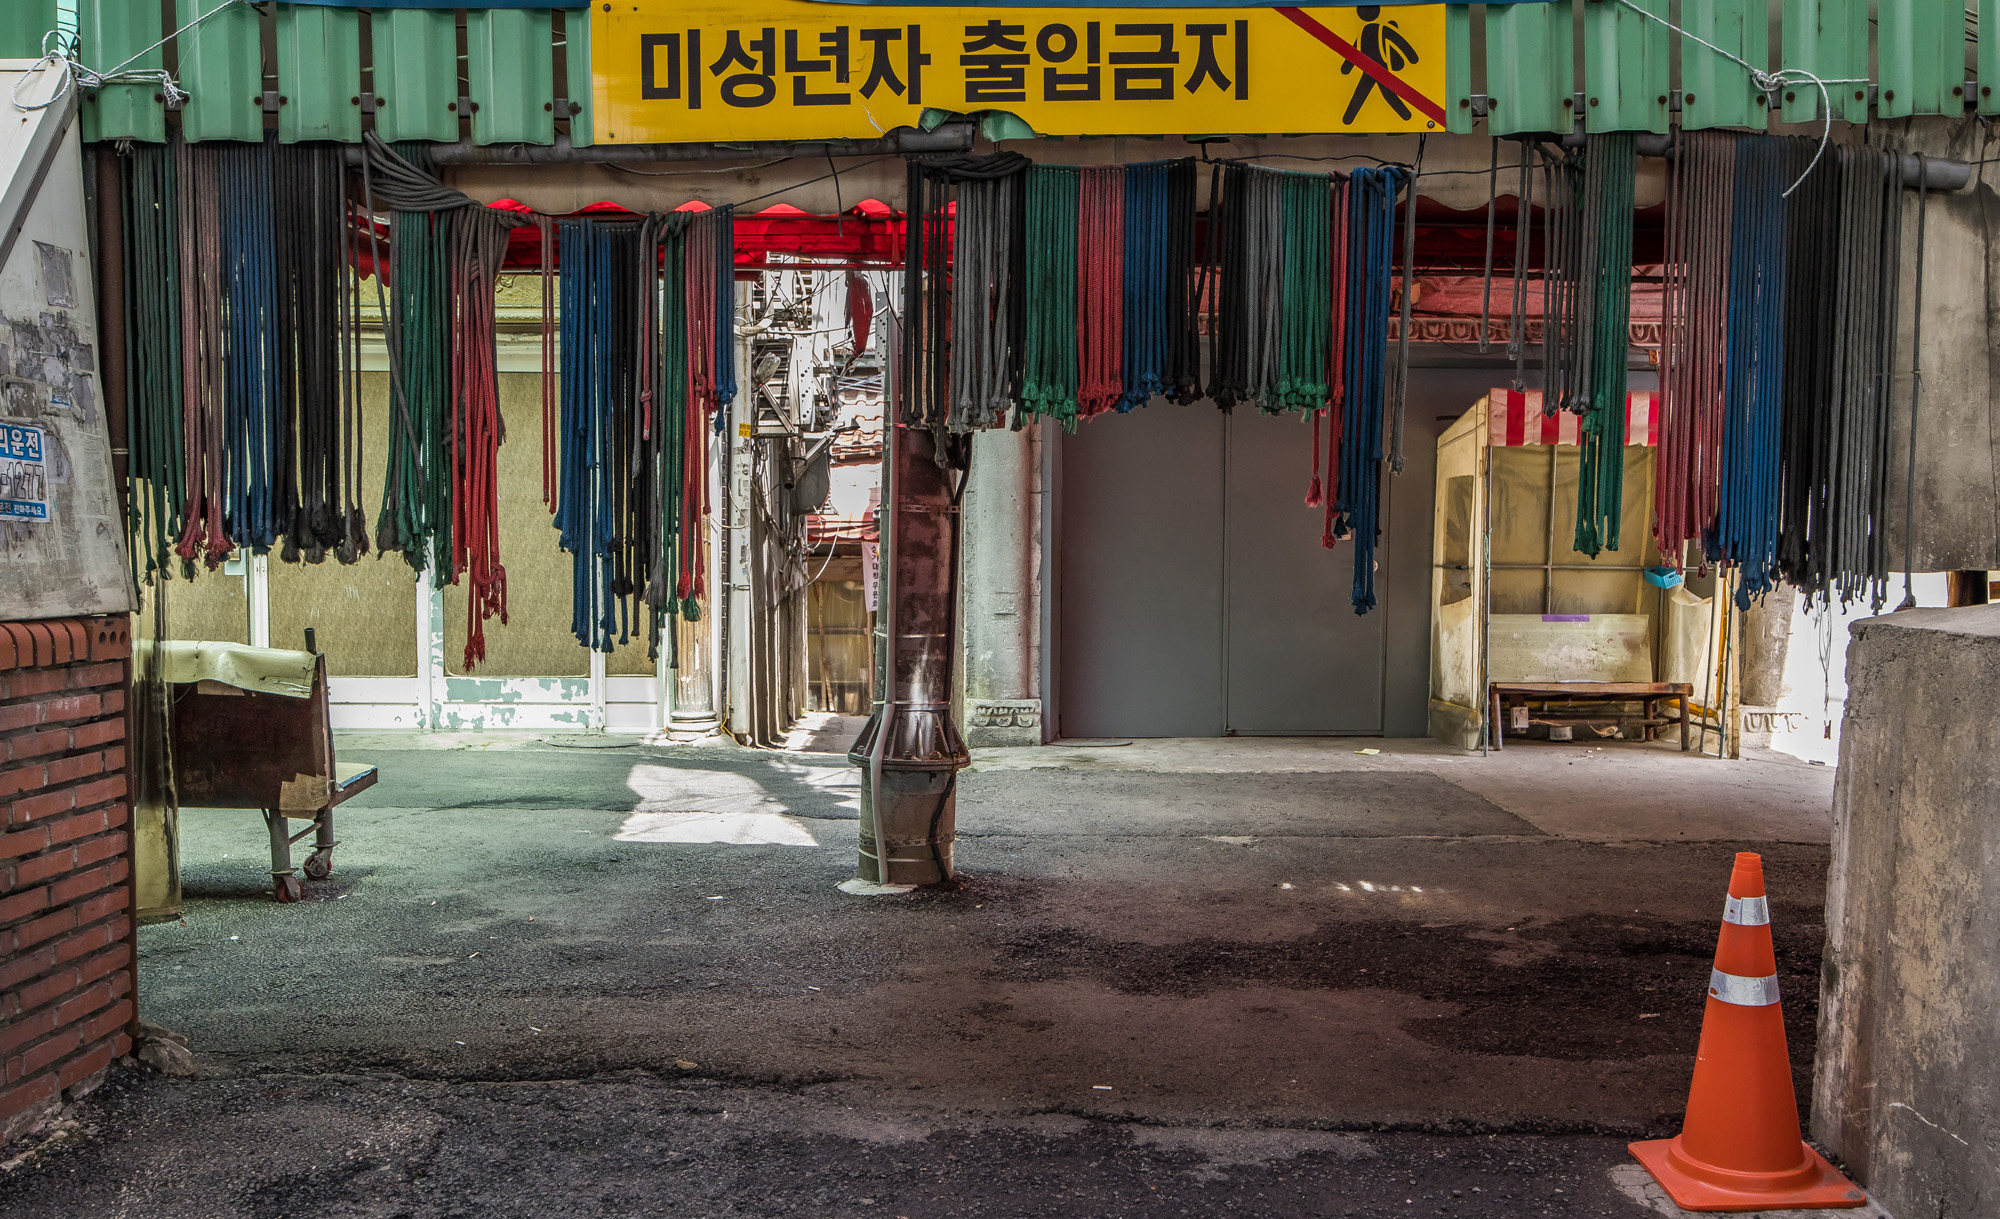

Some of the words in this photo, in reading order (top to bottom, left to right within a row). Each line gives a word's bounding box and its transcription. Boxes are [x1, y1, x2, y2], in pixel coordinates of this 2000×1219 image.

[640, 24, 932, 110] 미성년자
[959, 19, 1249, 103] 출입금지
[0, 461, 45, 501] -1277
